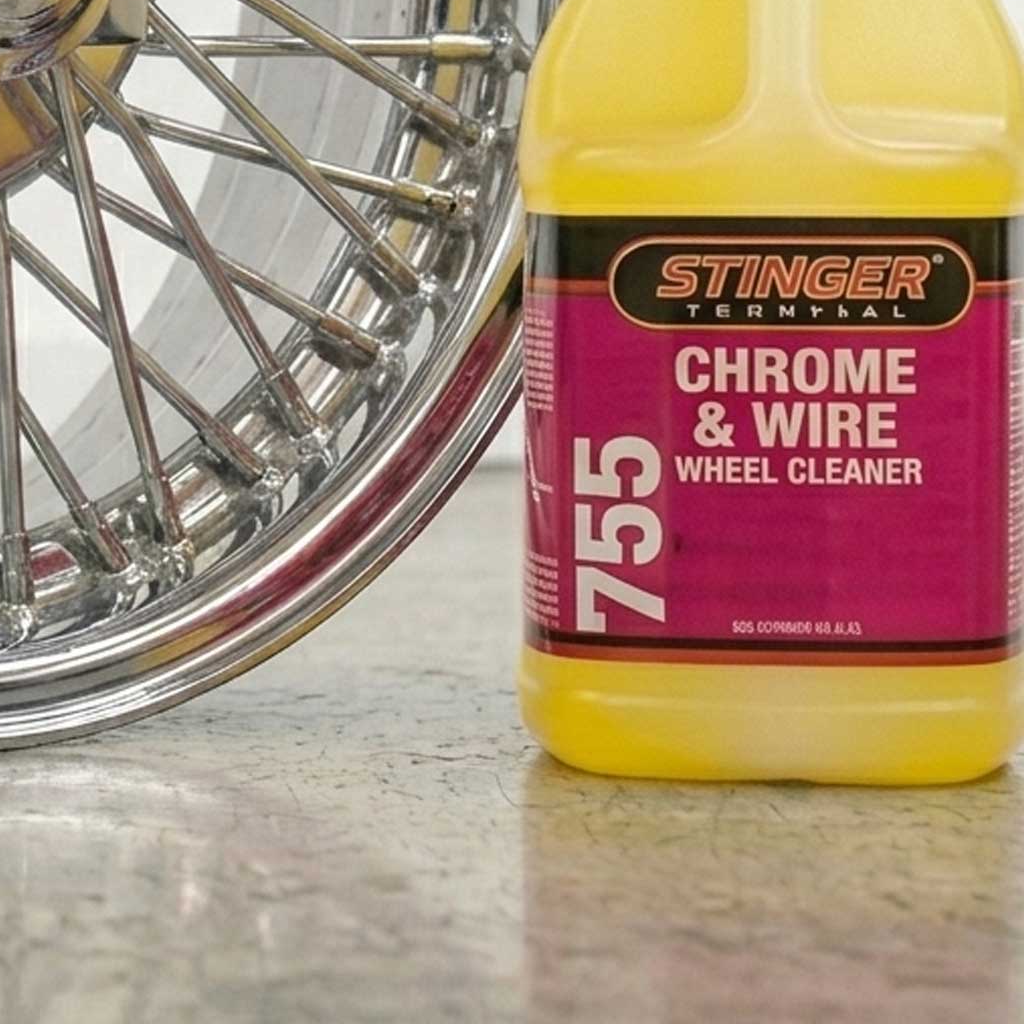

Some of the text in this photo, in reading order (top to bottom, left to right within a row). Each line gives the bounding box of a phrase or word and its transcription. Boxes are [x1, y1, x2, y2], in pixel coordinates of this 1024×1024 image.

[656, 255, 931, 299] STINGER
[675, 346, 917, 394] CHROME
[693, 401, 898, 448] & WIRE
[674, 456, 923, 485] WHEEL CLEANER
[574, 435, 666, 632] 755
